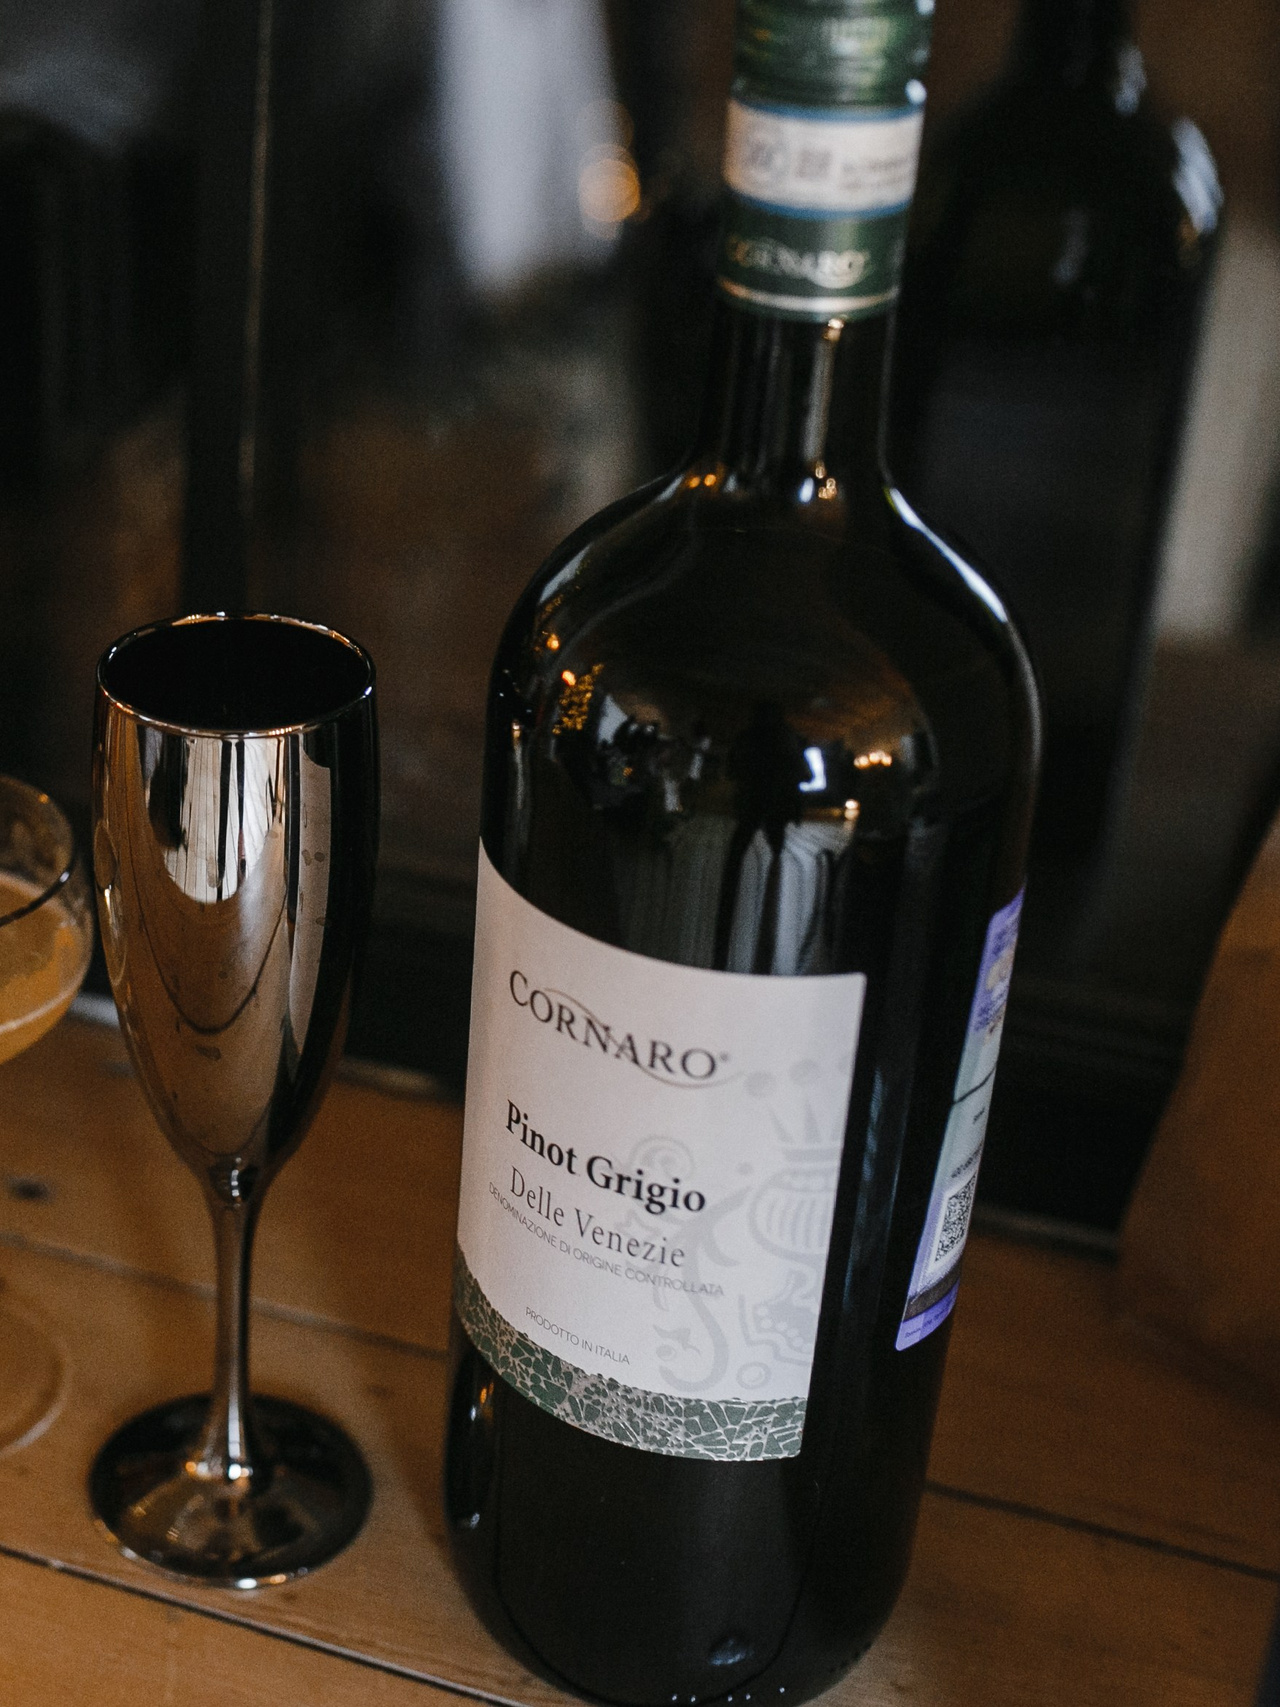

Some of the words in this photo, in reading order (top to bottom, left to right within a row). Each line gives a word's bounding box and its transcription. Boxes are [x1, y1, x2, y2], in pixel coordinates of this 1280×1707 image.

[509, 969, 718, 1080] CORNARO
[505, 1099, 579, 1176] Pinot
[585, 1155, 706, 1215] Grigio
[488, 1181, 557, 1248] DENOMINAZIONE
[559, 1240, 571, 1255] DI
[572, 1247, 622, 1277] ORIGINE
[624, 1267, 724, 1296] CONTROLLATA
[510, 1166, 565, 1227] Delle
[574, 1207, 686, 1268] Venezie
[525, 1306, 580, 1346] PRODOTTO
[581, 1339, 593, 1352] IN
[595, 1344, 630, 1365] ITALIA
